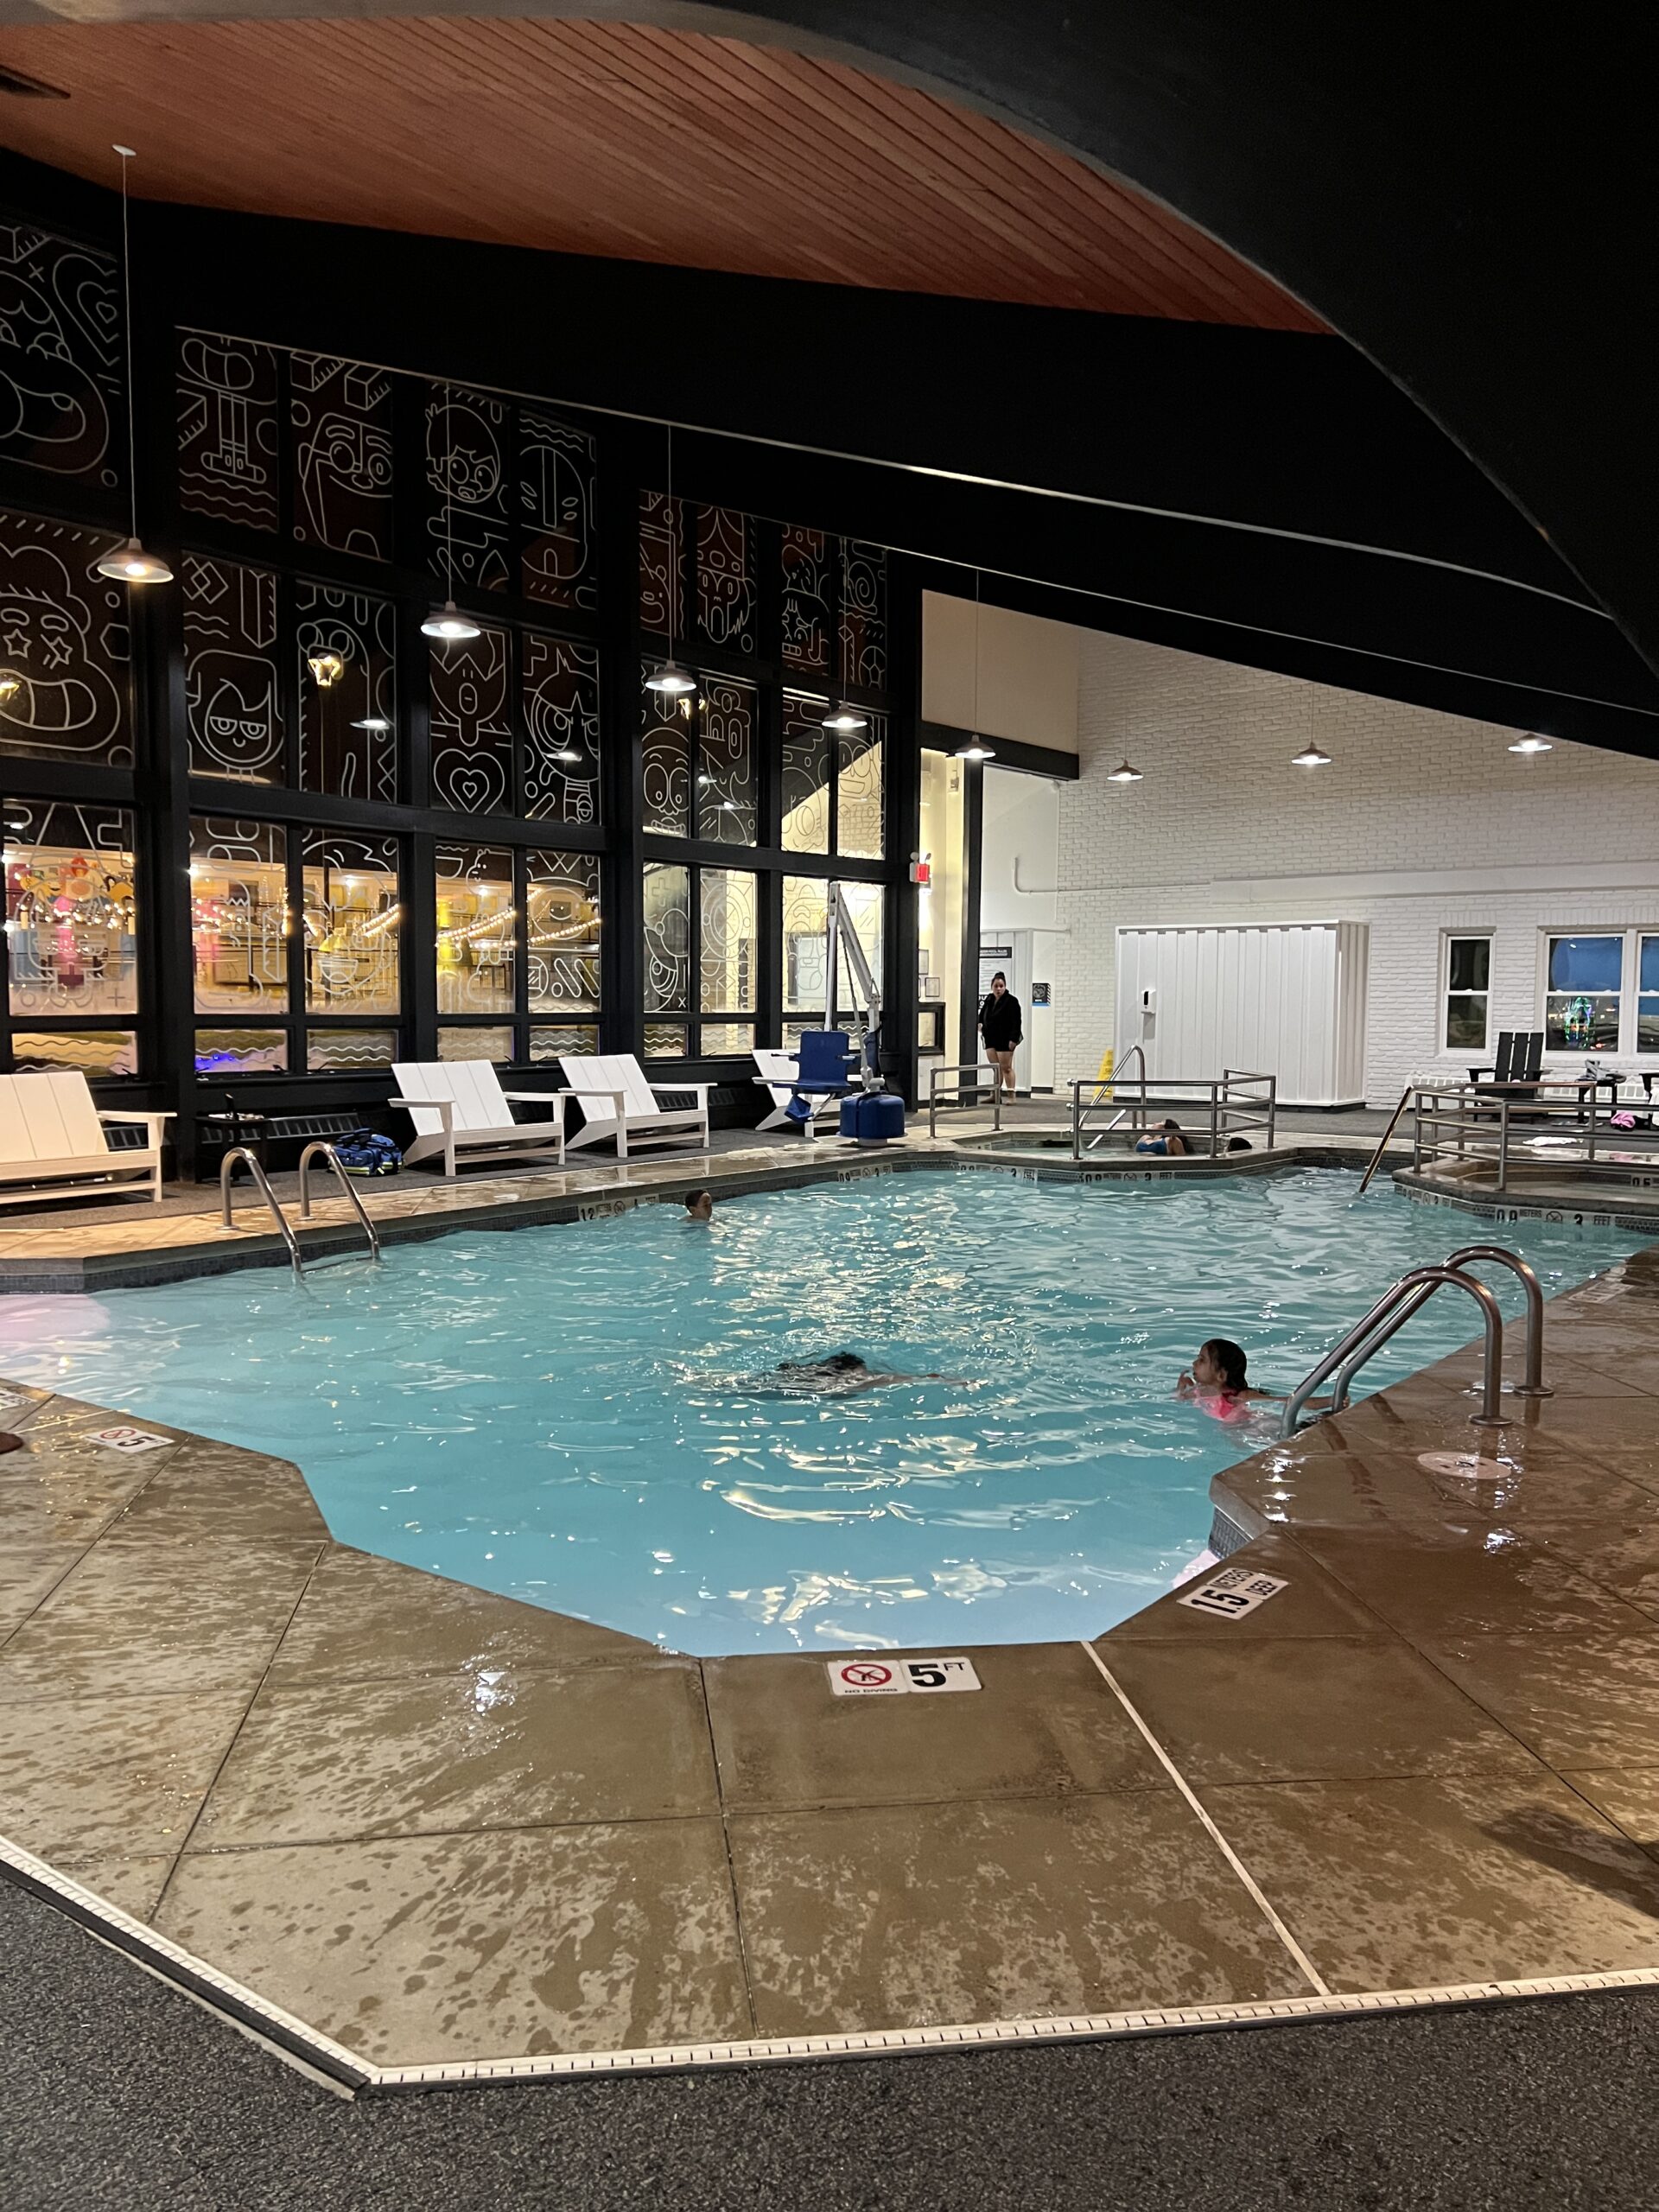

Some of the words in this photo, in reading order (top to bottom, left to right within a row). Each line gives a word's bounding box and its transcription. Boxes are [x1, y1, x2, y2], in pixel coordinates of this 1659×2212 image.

[117, 1435, 156, 1447] 5
[1209, 1568, 1254, 1590] METERS
[1244, 1580, 1278, 1597] DEEP
[1190, 1589, 1249, 1614] 1.5
[907, 1663, 947, 1688] 5
[944, 1662, 965, 1671] FT
